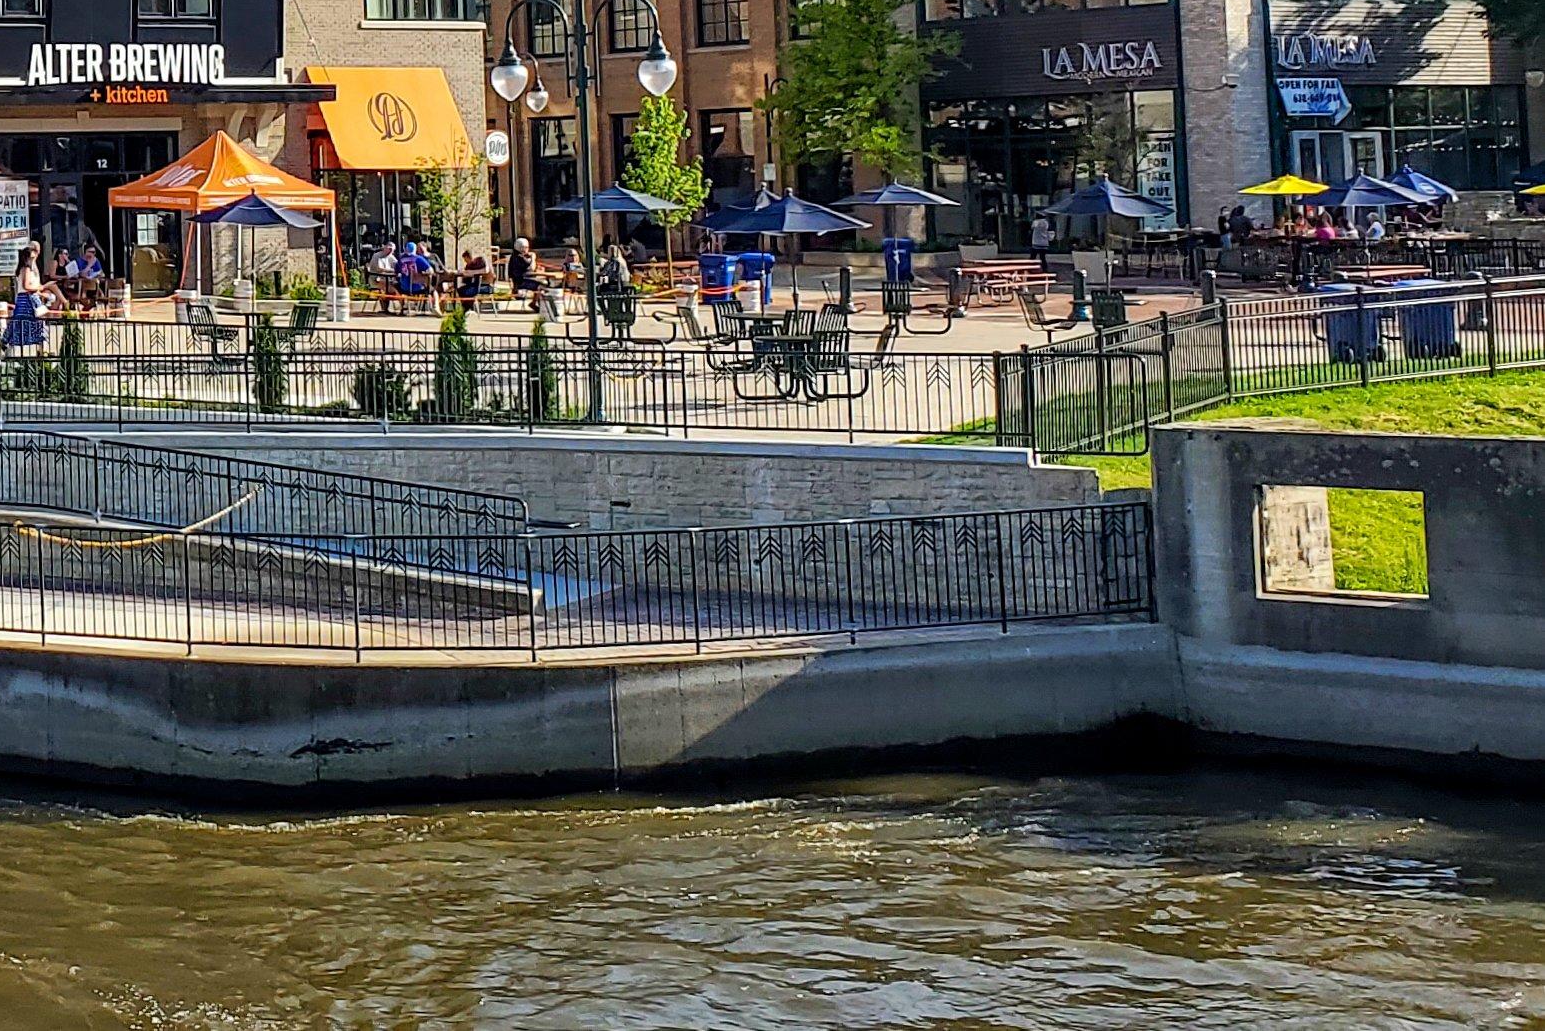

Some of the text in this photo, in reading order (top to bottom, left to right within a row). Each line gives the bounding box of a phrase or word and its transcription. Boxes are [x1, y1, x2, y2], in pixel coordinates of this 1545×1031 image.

[1041, 41, 1163, 79] LA MESA
[1272, 35, 1306, 70] LA
[28, 43, 225, 86] ALTER BREWING
[106, 85, 168, 104] kitchen
[96, 158, 108, 169] 12
[1146, 158, 1169, 168] FOR
[1146, 172, 1172, 182] TAKE
[1147, 186, 1171, 197] OUT
